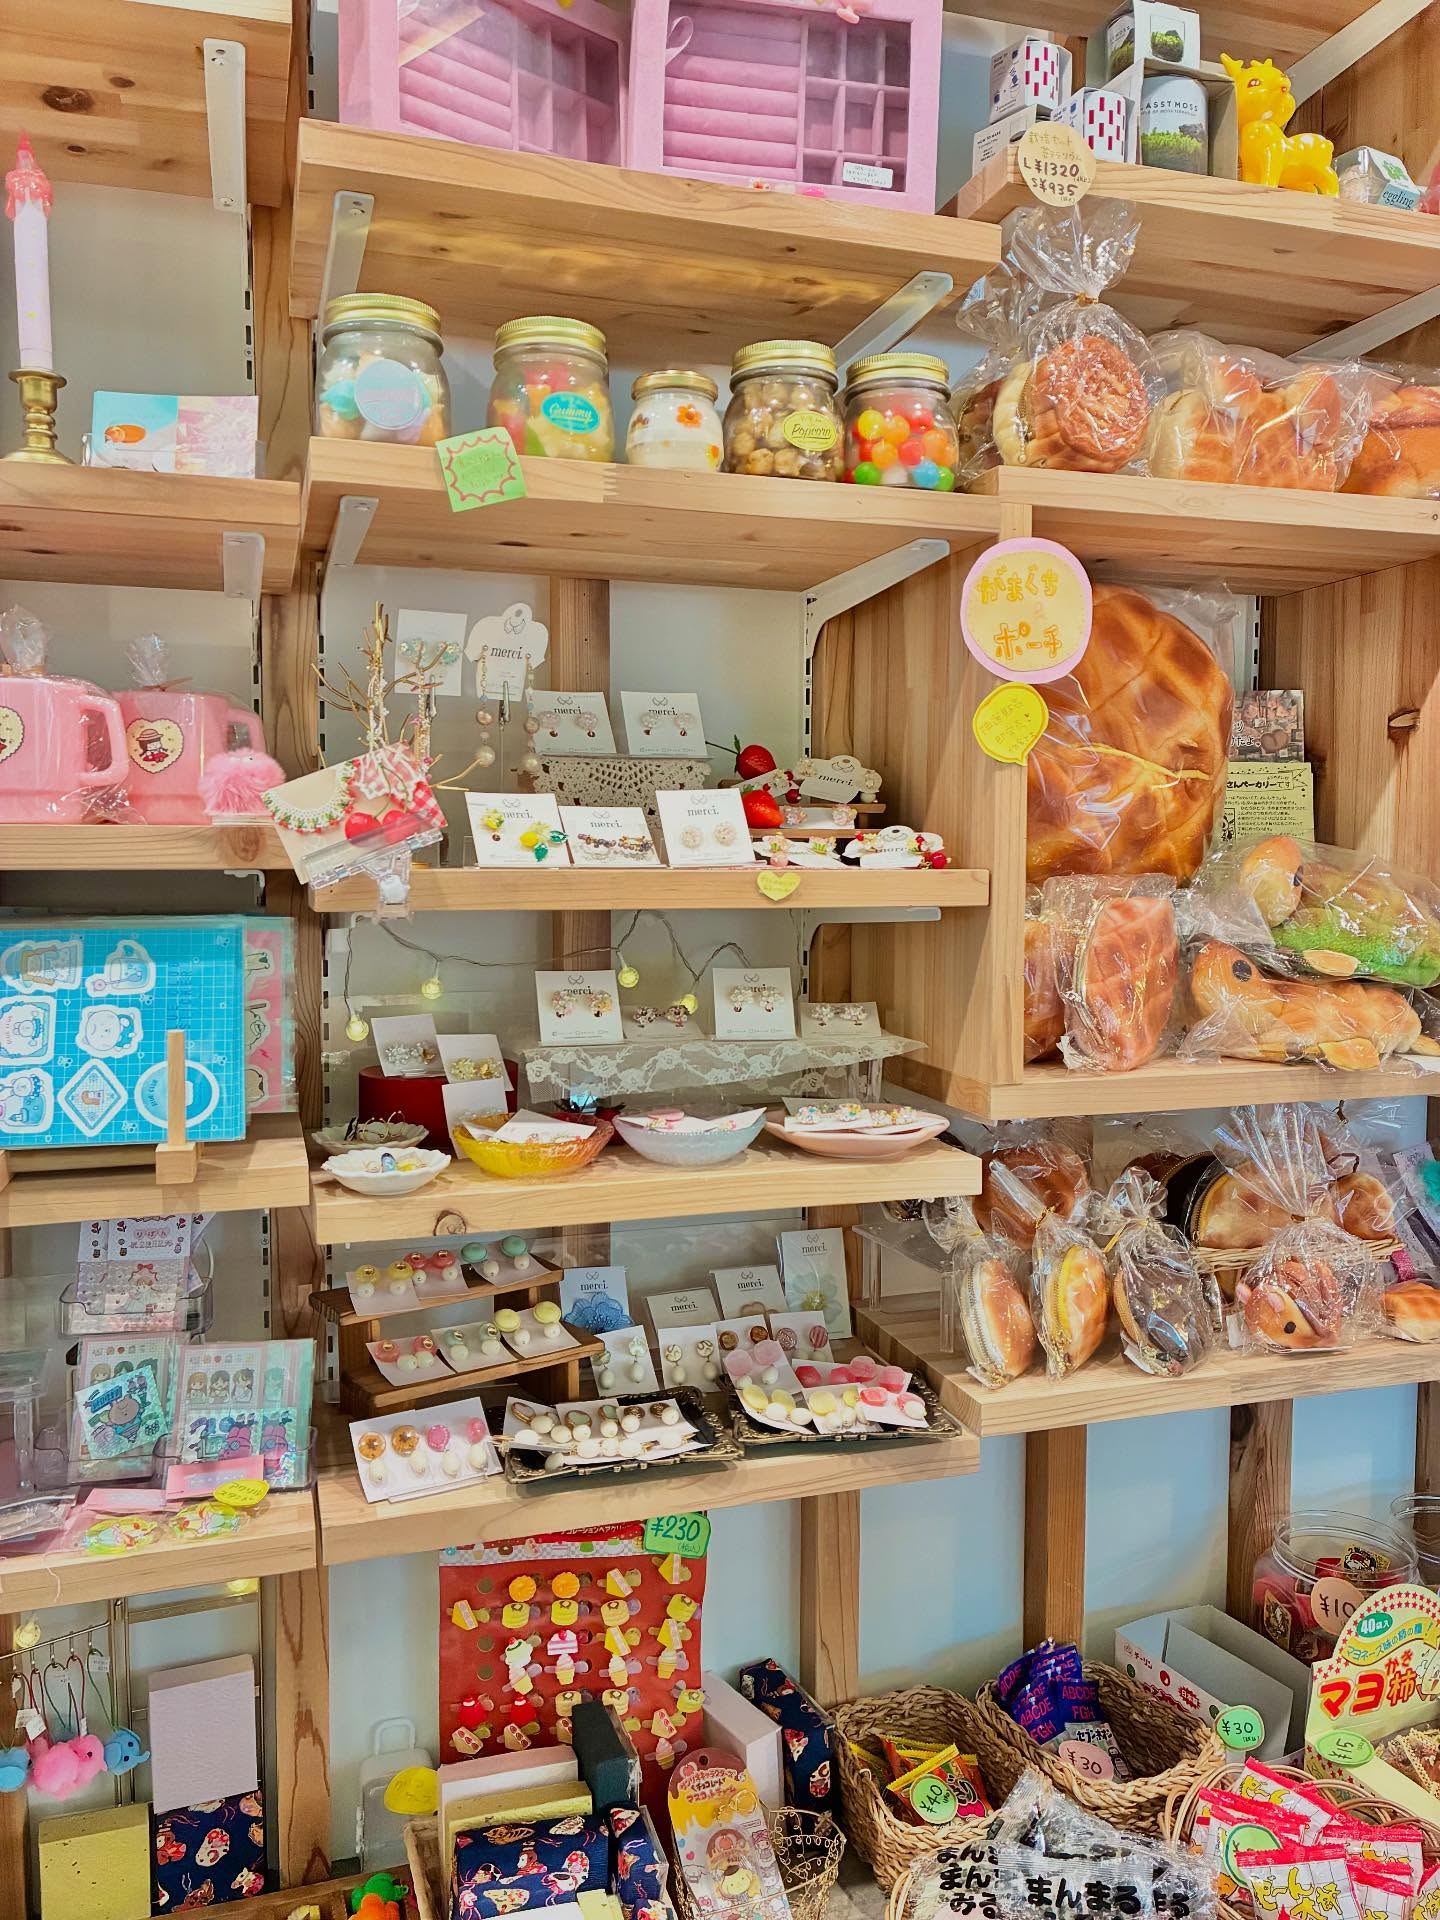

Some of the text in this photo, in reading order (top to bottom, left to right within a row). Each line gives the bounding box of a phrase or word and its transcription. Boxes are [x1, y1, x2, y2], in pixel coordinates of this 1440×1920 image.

[580, 1279, 608, 1291] merci.
[737, 1278, 764, 1290] merci.
[670, 1303, 699, 1312] merci.
[651, 1515, 701, 1541] ¥230
[1020, 1697, 1054, 1727] ABCDE
[1221, 1718, 1254, 1736] ¥30
[1066, 1747, 1102, 1775] ¥30
[919, 1784, 943, 1813] ¥40
[1026, 1874, 1142, 1915] まんまる
